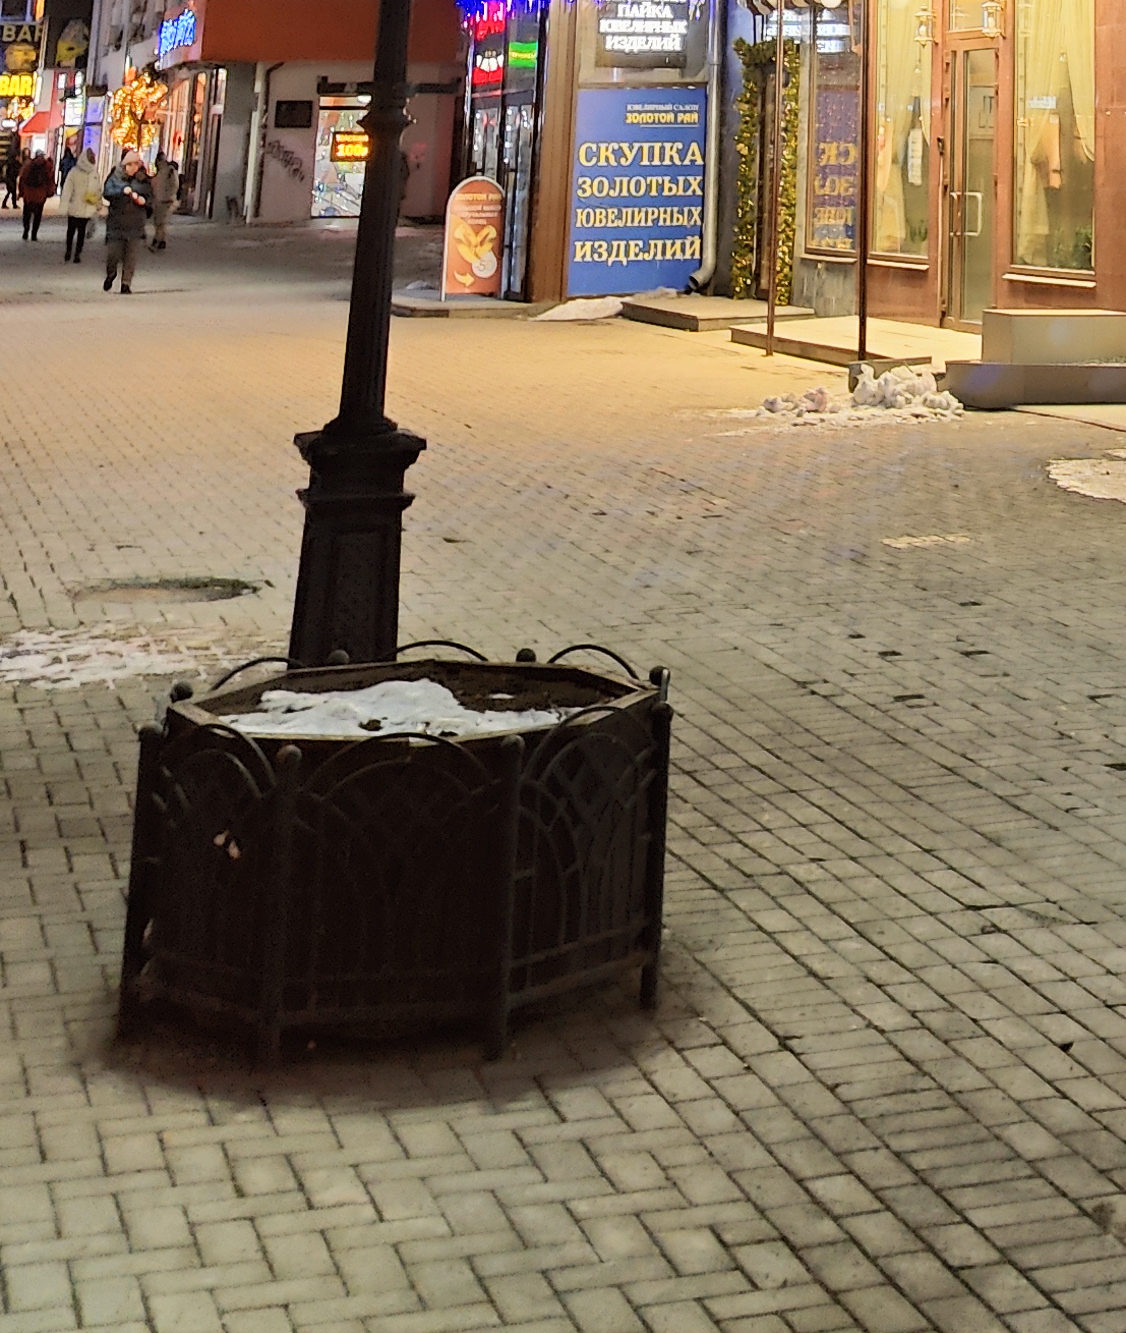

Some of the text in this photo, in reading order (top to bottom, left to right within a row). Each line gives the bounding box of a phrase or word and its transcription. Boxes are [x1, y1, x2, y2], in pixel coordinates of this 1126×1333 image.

[616, 1, 674, 19] ПАЙКА
[605, 33, 682, 53] ИЗДЕЛИЙ
[625, 112, 699, 124] ЗОЛОТОЙ РАЙ
[578, 141, 705, 167] СКУПКА
[577, 175, 704, 198] ЗОЛОТЫХ
[575, 206, 702, 228] ЮВЕЛИРНЫХ
[573, 236, 702, 267] ИЗДЕЛИЙ
